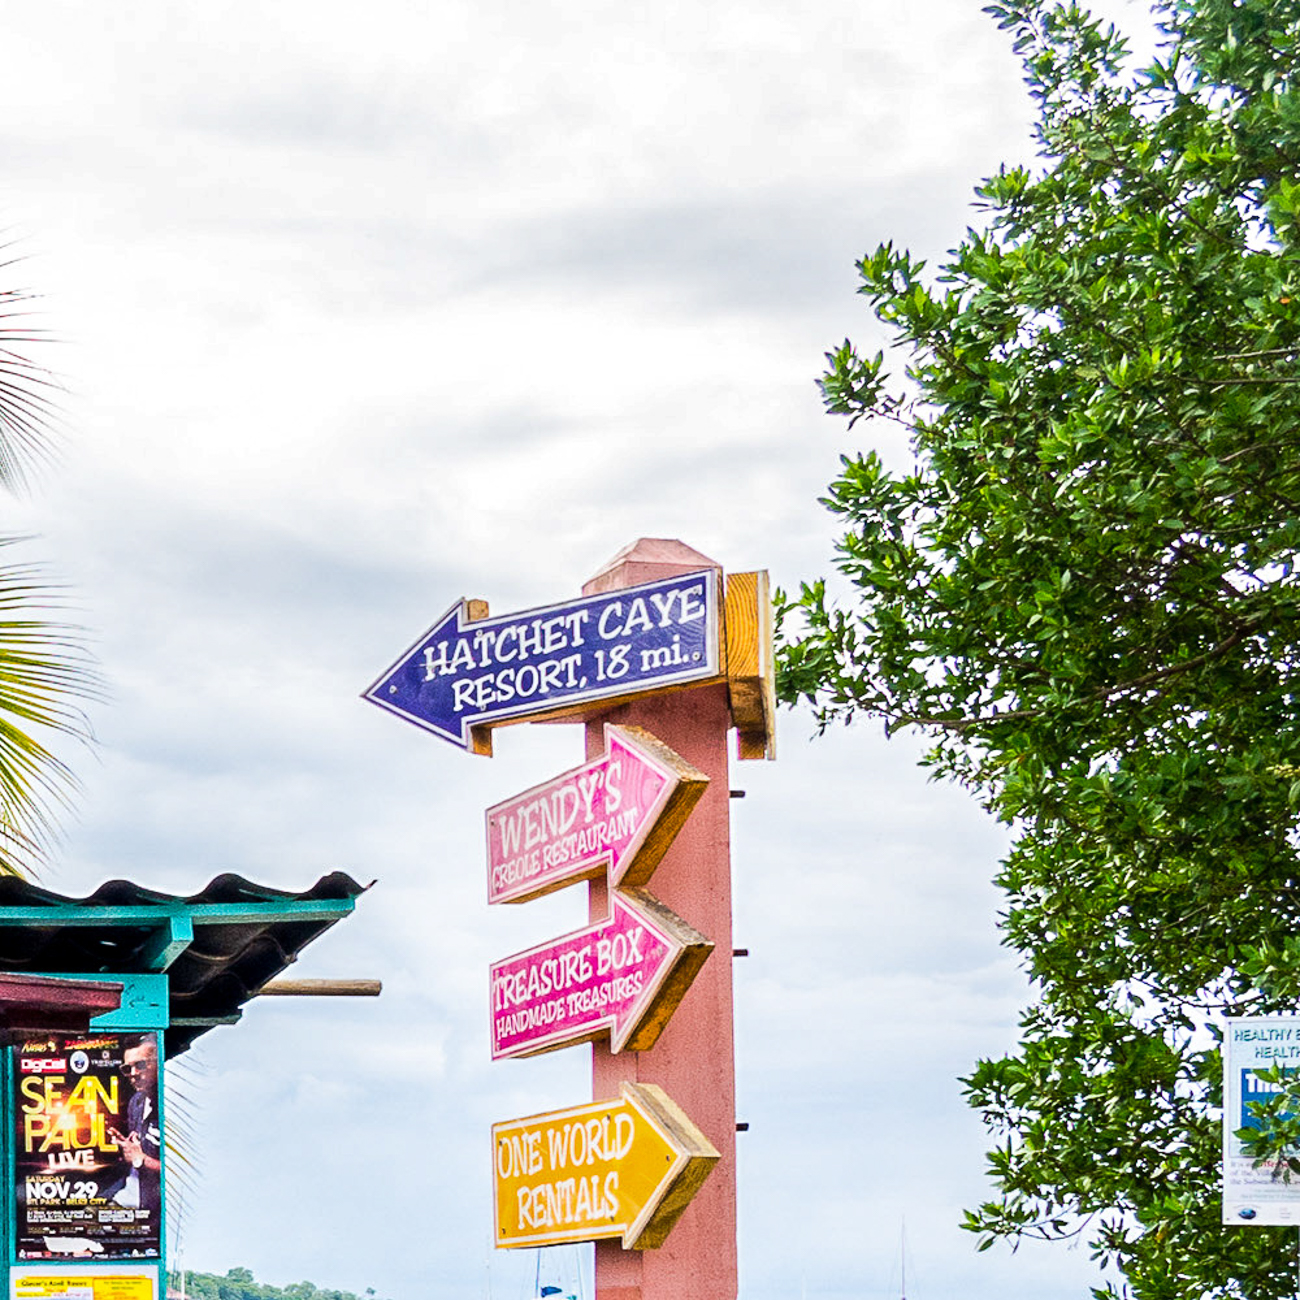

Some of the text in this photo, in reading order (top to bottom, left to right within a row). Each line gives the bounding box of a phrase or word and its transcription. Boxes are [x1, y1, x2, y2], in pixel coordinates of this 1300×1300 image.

[423, 584, 706, 681] HATCHET CAYE
[451, 635, 690, 711] RESORT, 18 mi.
[500, 759, 622, 858] WENDY'S
[492, 807, 639, 889] CREOLE RESTAURANT
[492, 927, 643, 1011] TREASURE BOX
[496, 971, 643, 1040] HANDMADE TREASURES
[1234, 1029, 1291, 1042] HEALTHY
[21, 1076, 119, 1115] SEAN
[25, 1113, 119, 1153] PAUL
[48, 1150, 95, 1168] LIVE
[498, 1113, 635, 1178] ONE WORLD
[26, 1175, 65, 1183] SATURDAY
[517, 1171, 620, 1230] RENTALS
